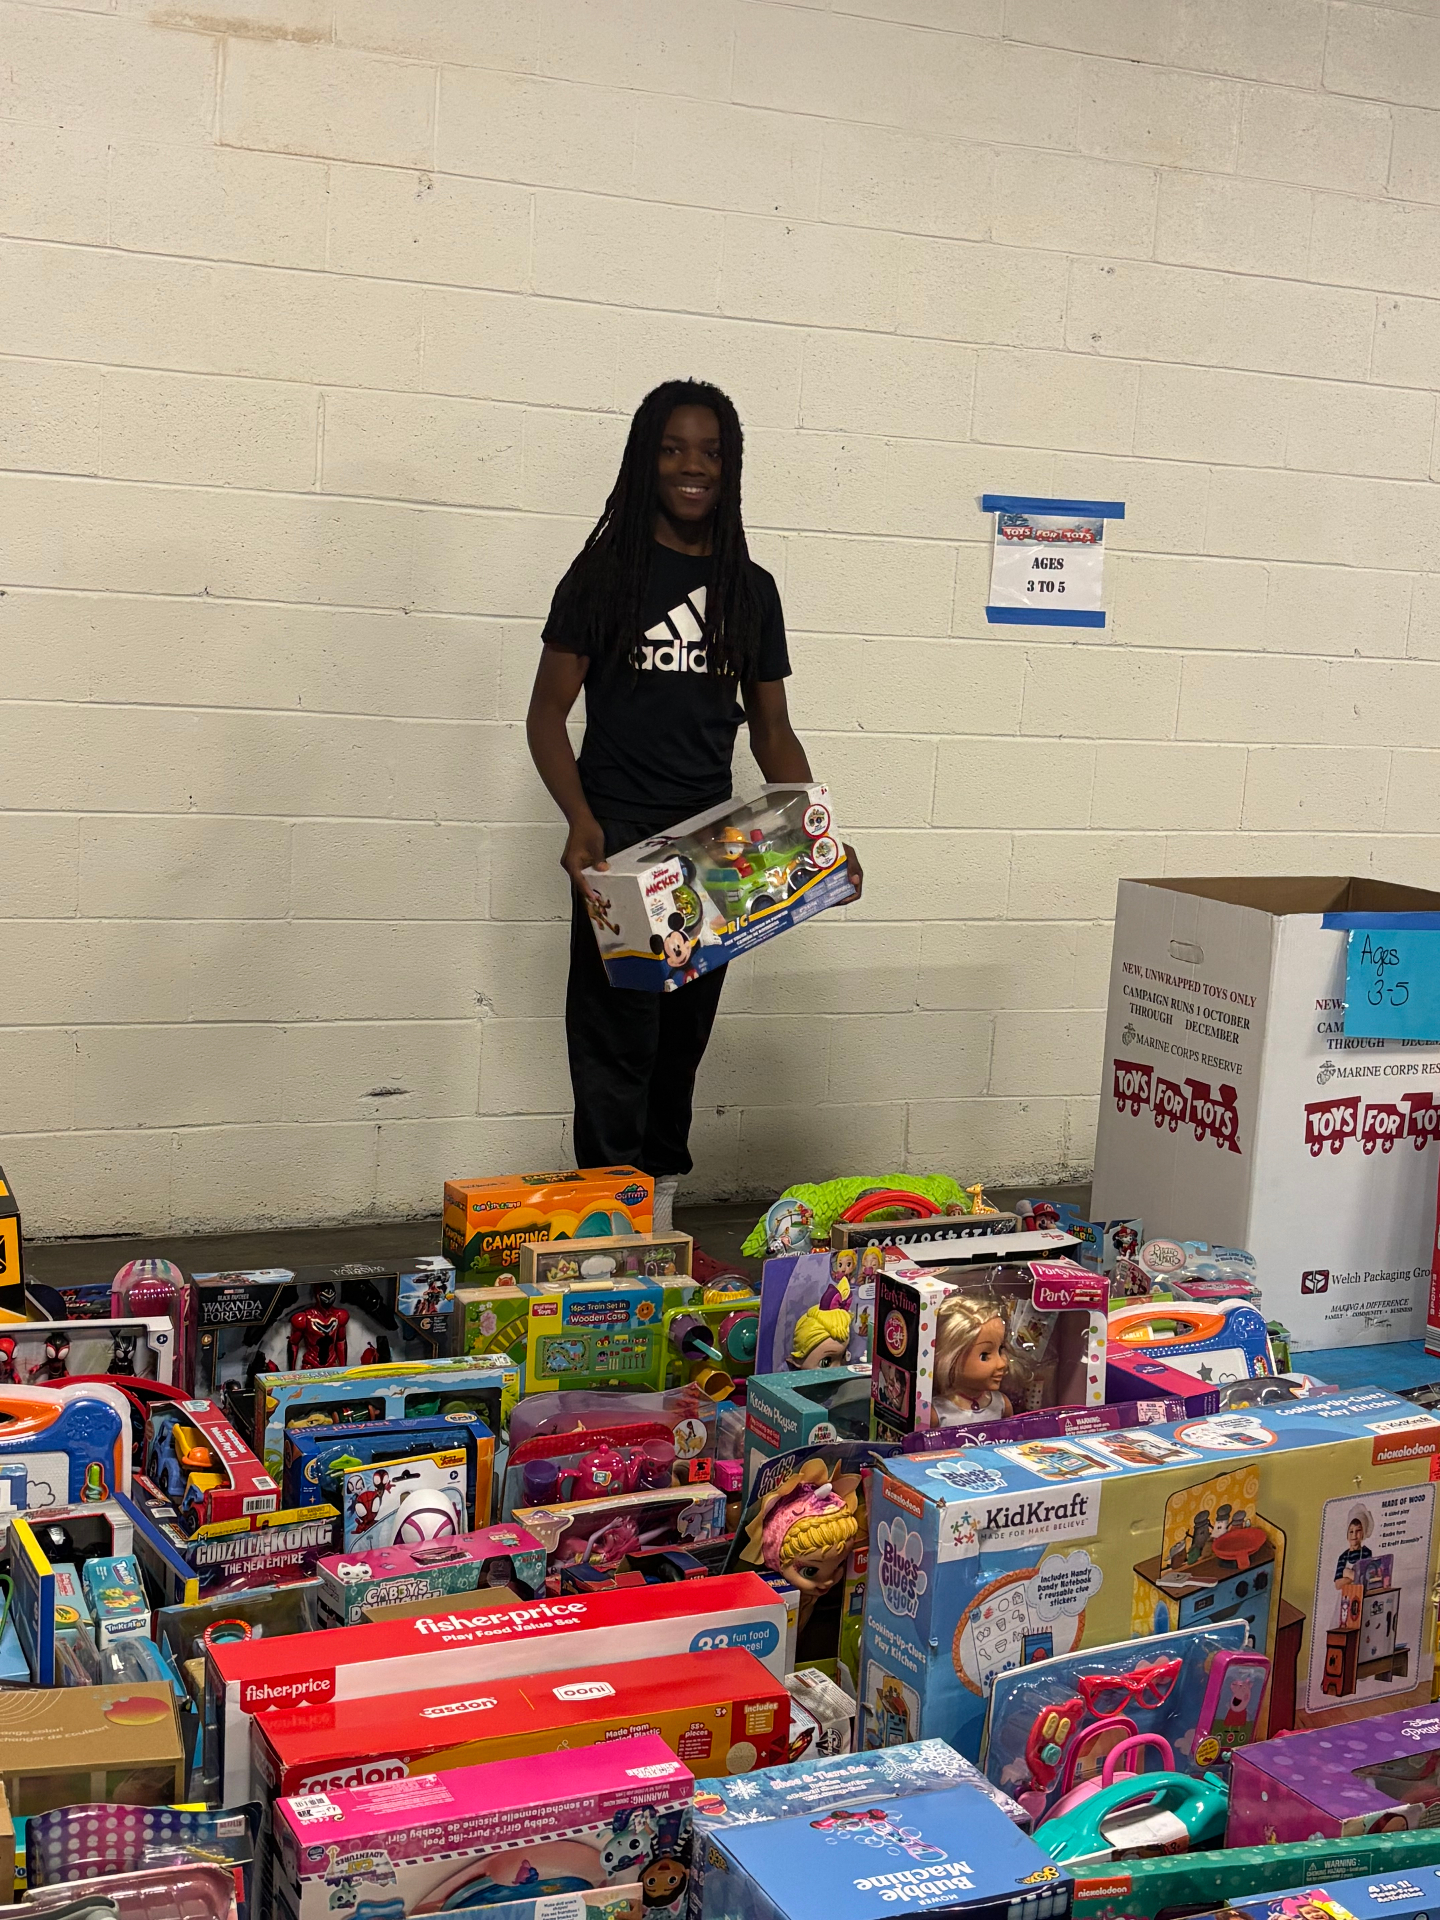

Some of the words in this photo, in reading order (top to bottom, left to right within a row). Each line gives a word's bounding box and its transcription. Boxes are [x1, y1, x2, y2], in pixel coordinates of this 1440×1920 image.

[1005, 527, 1031, 536] TOYS
[1036, 530, 1058, 538] FOR
[1063, 531, 1092, 541] TOTS
[1032, 557, 1064, 570] AGES
[1027, 580, 1035, 593] 3
[1038, 581, 1054, 593] TO
[1058, 581, 1066, 593] 5
[645, 872, 680, 897] MICKEY
[1361, 934, 1400, 976] Ages
[1122, 962, 1143, 979] NEW,
[1146, 968, 1201, 993] UNWRAPPED
[1203, 984, 1227, 1000] TOYS
[1230, 991, 1257, 1008] ONLY
[1368, 980, 1409, 1006] 3-5
[1123, 984, 1169, 1007] CAMPAIGN
[1171, 998, 1194, 1014] RUNS
[1203, 1007, 1250, 1030] OCTOBER
[1129, 1003, 1173, 1025] THROUGH
[1185, 1019, 1240, 1044] DECEMBER
[1327, 1038, 1385, 1049] THROUGH
[1136, 1033, 1170, 1053] MARINE
[1171, 1045, 1199, 1062] CORPS
[1201, 1054, 1242, 1075] RESERVE
[1337, 1065, 1381, 1079] MARINE
[1384, 1064, 1419, 1076] CORPS
[1116, 1070, 1149, 1099] TOYS
[1156, 1084, 1184, 1117] FOR
[1193, 1099, 1233, 1135] TOTS
[1309, 1105, 1354, 1137] TOYS
[1365, 1109, 1400, 1135] FOR
[1066, 1230, 1096, 1243] MARIO
[1069, 1225, 1093, 1234] SUPER
[482, 1230, 549, 1252] CAMPING
[502, 1249, 520, 1267] SE
[1332, 1272, 1361, 1285] Welch
[1364, 1269, 1411, 1283] Packaging
[1413, 1267, 1431, 1278] Gro
[1040, 1290, 1075, 1306] Party
[1428, 1273, 1438, 1315] SPORTS
[202, 1300, 264, 1313] WAKANDA
[1331, 1303, 1359, 1313] MAKING
[1366, 1298, 1409, 1309] DIFFERENCE
[203, 1310, 263, 1323] FOREVER
[570, 1314, 604, 1323] Wooden
[607, 1312, 626, 1320] Case
[750, 1391, 773, 1418] Kitchen
[773, 1407, 798, 1433] Playset
[1275, 1392, 1387, 1416] Cooking-Up-Clues
[1317, 1408, 1349, 1418] Play
[1349, 1400, 1400, 1413] Kitchen
[333, 1420, 392, 1433] playset
[814, 1431, 831, 1440] Make
[1377, 1443, 1436, 1461] nickelodeon
[950, 1476, 995, 1488] Clues
[1382, 1498, 1398, 1508] MADE
[1400, 1497, 1407, 1505] OF
[1409, 1494, 1426, 1503] WOOD
[986, 1493, 1088, 1530] KidKraft
[980, 1531, 1005, 1540] MADE
[1028, 1527, 1050, 1535] MAKE
[1053, 1520, 1086, 1530] BELIEVE
[196, 1536, 265, 1566] GODZILLA
[270, 1524, 333, 1553] KONG
[221, 1563, 243, 1577] THE
[243, 1558, 265, 1574] NEW
[266, 1551, 308, 1568] EMPIRE
[884, 1540, 919, 1581] Blue's
[882, 1562, 916, 1598] Clues
[1041, 1572, 1069, 1583] Includes
[1070, 1568, 1092, 1579] Handy
[365, 1581, 429, 1603] GABBY'S
[1038, 1583, 1058, 1593] Dandy
[1061, 1577, 1092, 1588] Notebook
[1045, 1589, 1074, 1599] reusable
[1075, 1585, 1089, 1594] clue
[1049, 1596, 1077, 1607] stickers
[414, 1602, 587, 1635] fisher-price
[442, 1634, 474, 1643] Play
[476, 1626, 512, 1638] Food
[513, 1621, 553, 1632] Value
[554, 1617, 581, 1626] Set
[732, 1633, 747, 1642] fun
[749, 1629, 769, 1640] food
[868, 1615, 926, 1664] Cooking-Up-Clues
[875, 1634, 889, 1655] Play
[890, 1646, 917, 1673] Kitchen
[245, 1678, 331, 1702] fisher-price
[564, 1684, 607, 1697] ooni
[423, 1698, 494, 1716] casdon
[714, 1708, 728, 1717] 3+
[744, 1702, 779, 1714] Includes
[605, 1727, 629, 1739] Made
[632, 1723, 650, 1734] from
[633, 1728, 662, 1739] Plastic
[685, 1729, 709, 1738] pieces
[690, 1722, 705, 1730] 55+
[299, 1766, 405, 1796] casdon
[584, 1799, 595, 1808] La
[630, 1790, 669, 1806] WARNING:
[501, 1801, 583, 1822] senchationnelle
[447, 1822, 461, 1832] de
[462, 1815, 500, 1830] piscine
[423, 1836, 446, 1848] Pool
[448, 1828, 490, 1844] Purr-ific
[336, 1851, 386, 1866] ADVENTURES
[346, 1858, 374, 1874] CAT
[852, 1861, 976, 1891] Machine
[878, 1876, 977, 1902] Bubble
[1078, 1885, 1127, 1897] nickelodeon
[1368, 1885, 1380, 1893] 4
[1380, 1882, 1397, 1890] in
[918, 1894, 959, 1906] MOWER
